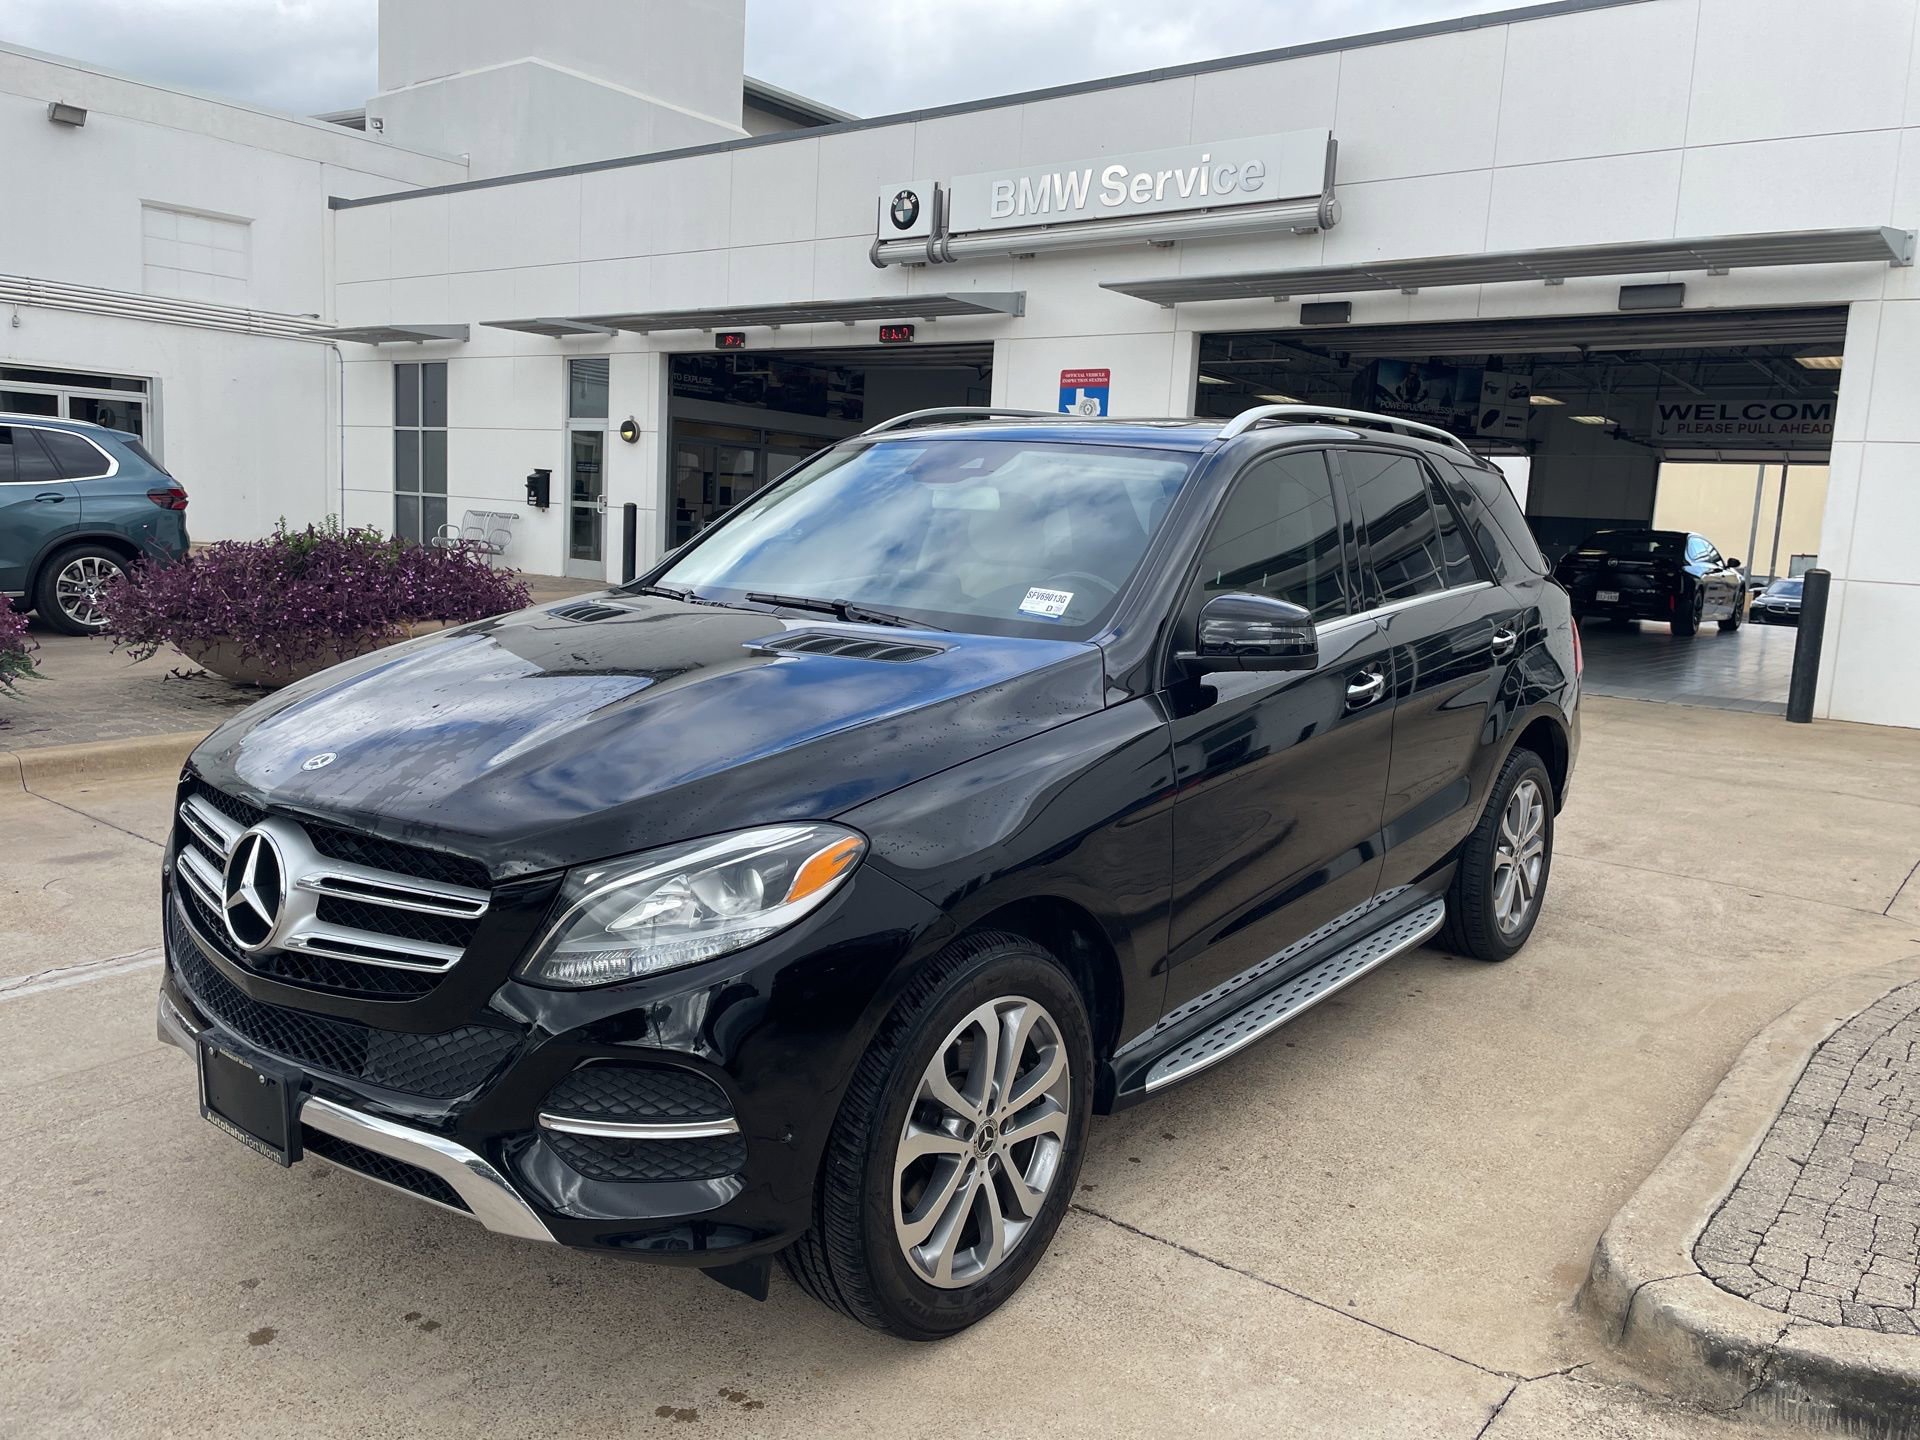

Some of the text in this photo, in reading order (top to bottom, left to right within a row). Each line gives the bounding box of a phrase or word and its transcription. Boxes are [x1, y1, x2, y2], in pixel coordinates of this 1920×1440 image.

[892, 191, 917, 206] BMW
[991, 153, 1266, 219] BMW Service
[1677, 423, 1833, 434] PLEASE PULL AHEAD
[207, 1111, 245, 1143] Autobahn
[260, 1143, 282, 1163] Worth
